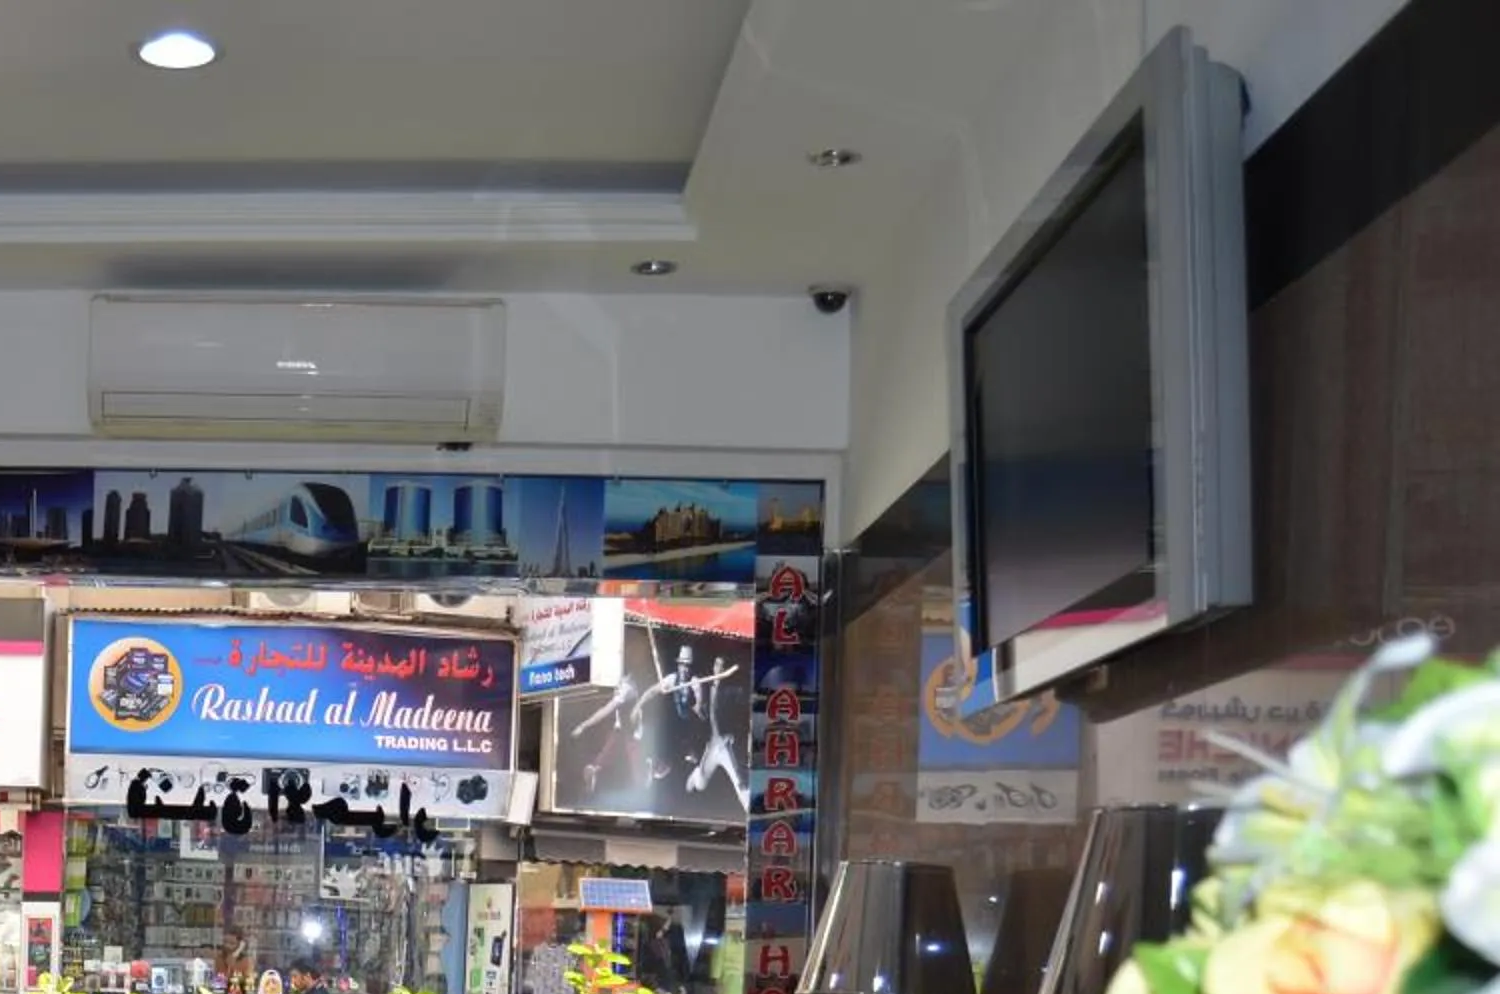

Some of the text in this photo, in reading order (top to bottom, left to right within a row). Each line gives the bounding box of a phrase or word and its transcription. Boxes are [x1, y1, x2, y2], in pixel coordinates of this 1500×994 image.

[228, 638, 496, 688] رشاد المدينة للتجارة
[192, 683, 493, 733] Rashad al Madeena
[374, 735, 493, 753] TRADING L.L.C
